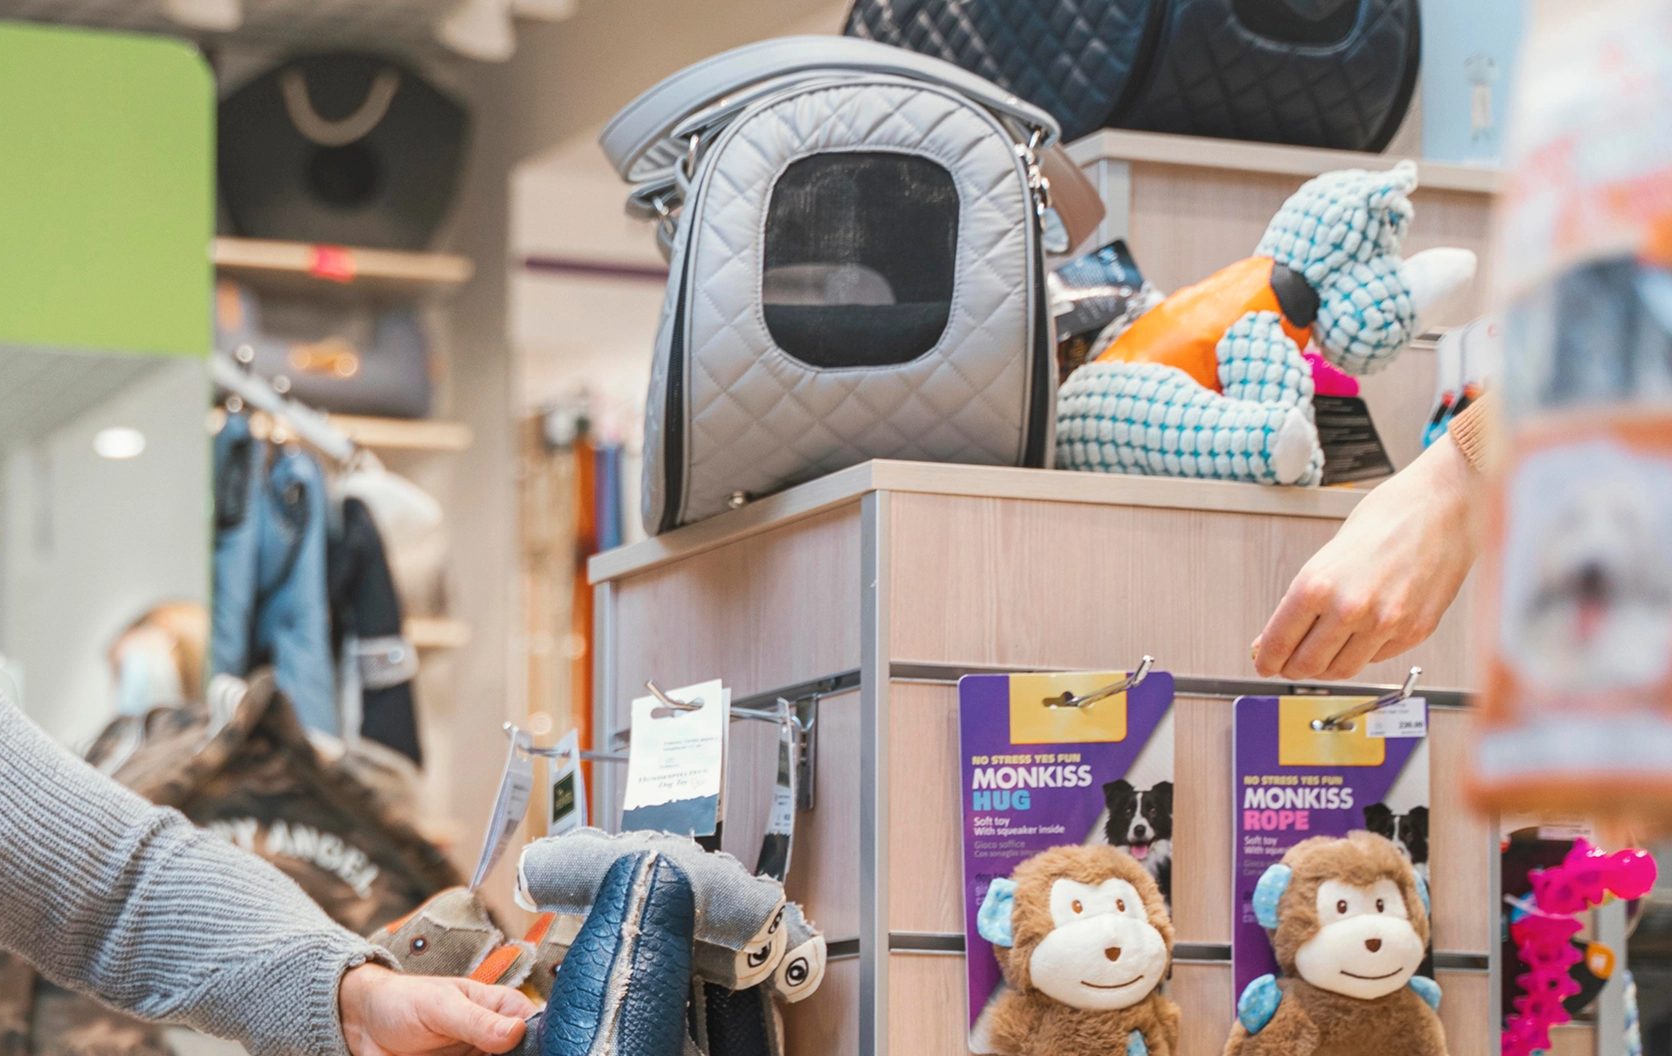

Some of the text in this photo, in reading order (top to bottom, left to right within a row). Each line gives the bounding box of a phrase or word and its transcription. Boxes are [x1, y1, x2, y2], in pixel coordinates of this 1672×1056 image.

[972, 752, 1081, 765] NO STRESS YES FUN
[972, 766, 1093, 789] MONKISS
[1243, 775, 1343, 785] NO STRESS YES FUN
[973, 789, 1031, 811] HUG
[1243, 787, 1354, 809] MONKISS
[973, 816, 1011, 828] Soft toy
[1243, 810, 1310, 831] ROPE
[973, 824, 1066, 837] With squeaker inside
